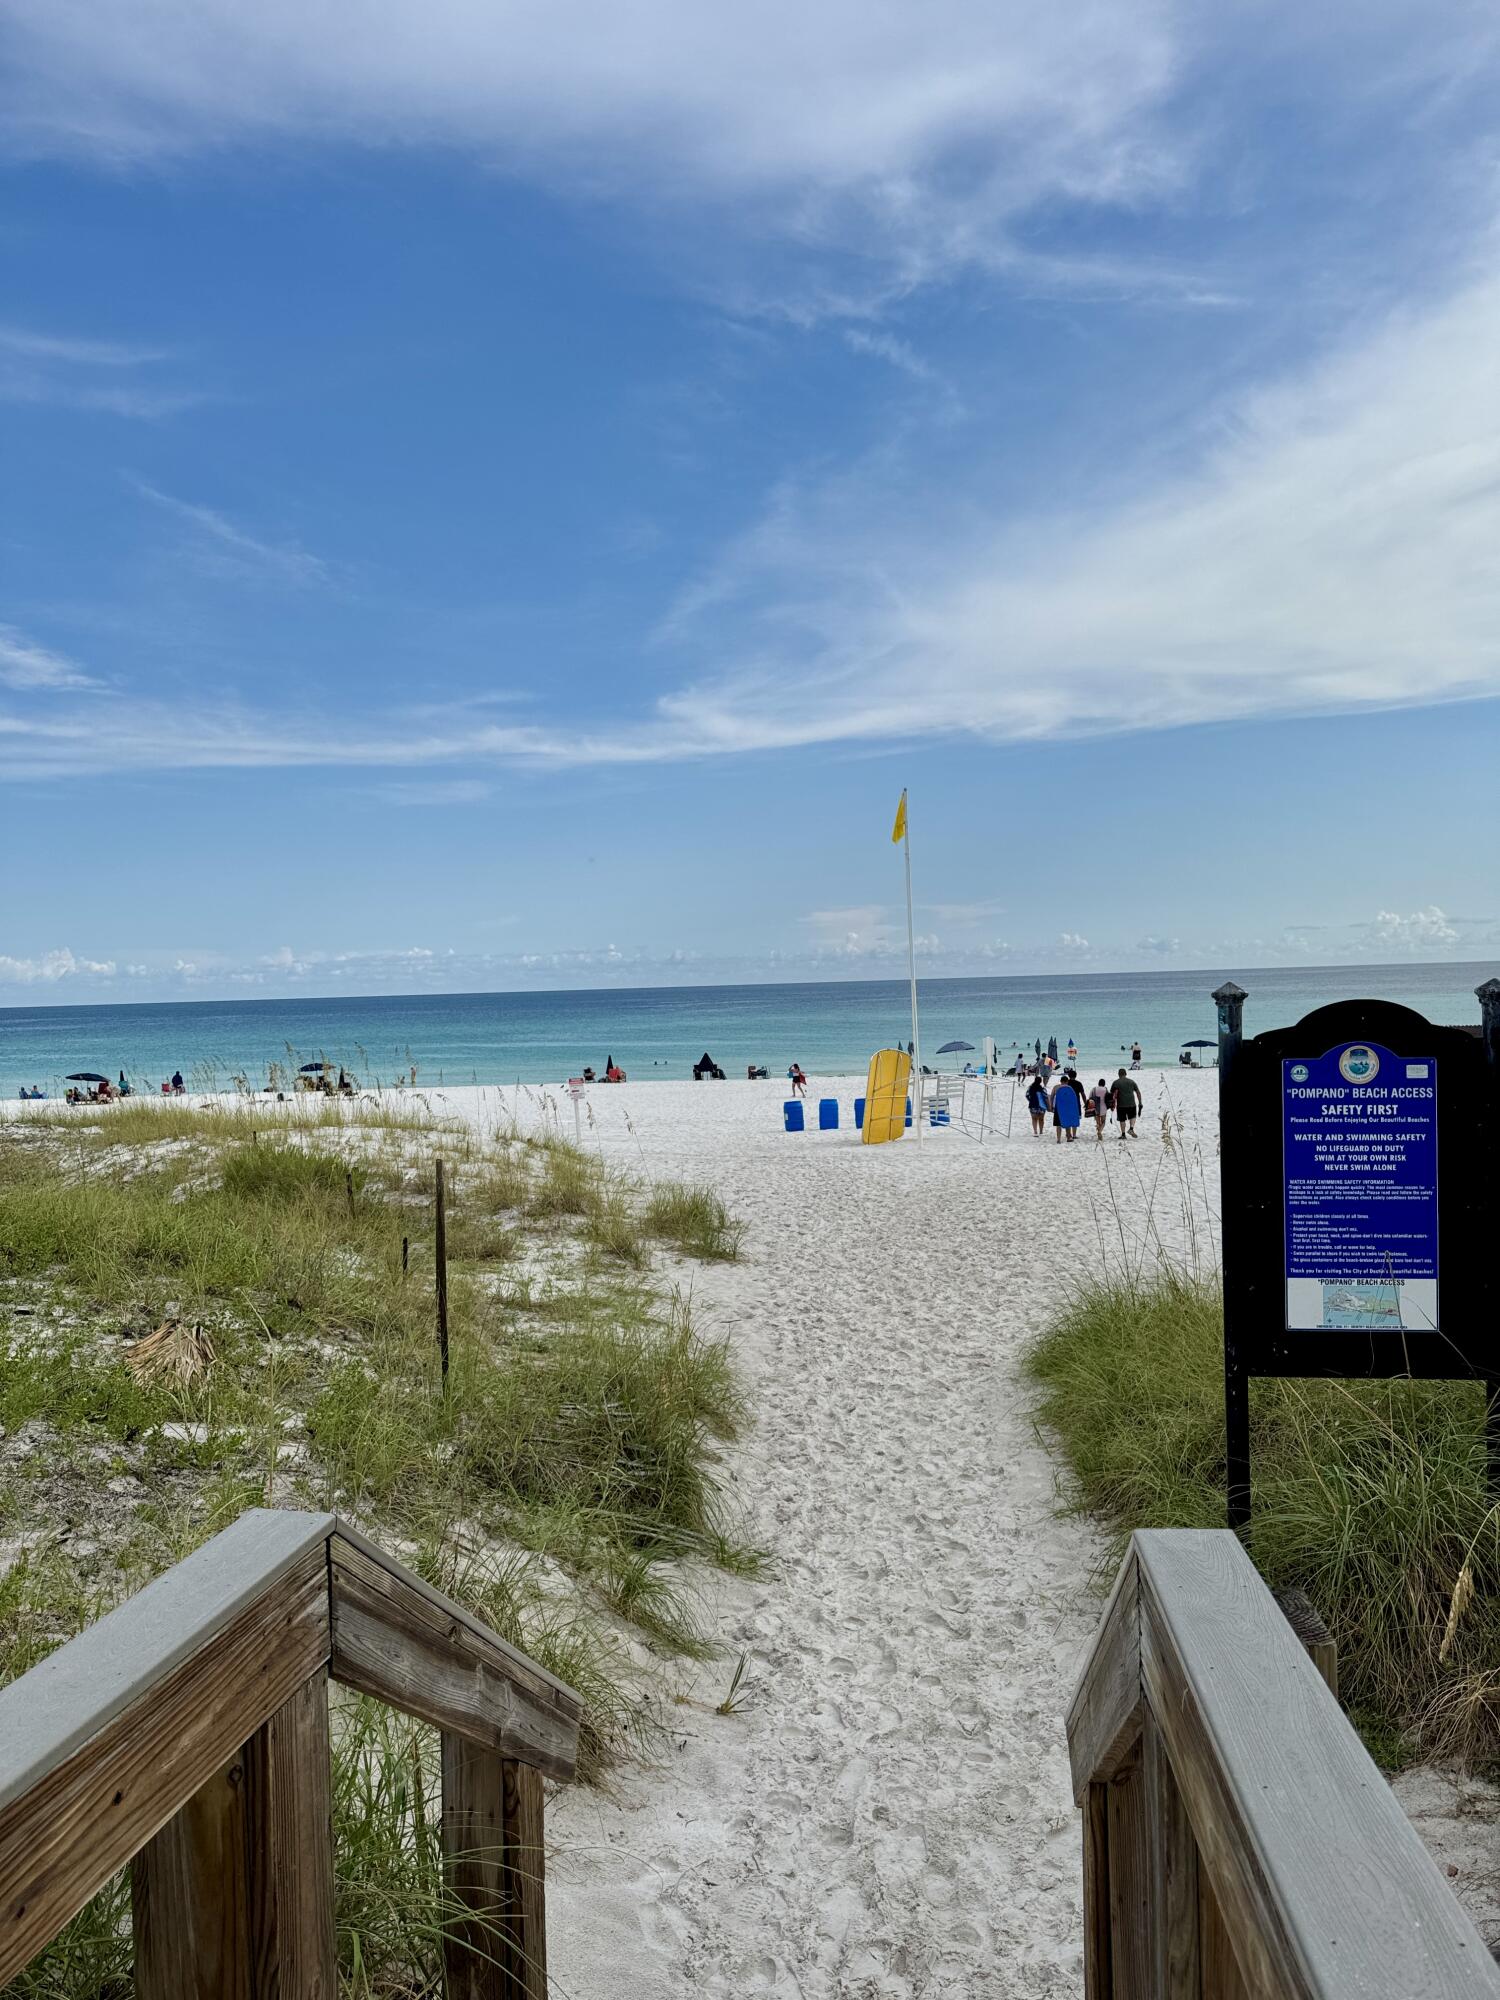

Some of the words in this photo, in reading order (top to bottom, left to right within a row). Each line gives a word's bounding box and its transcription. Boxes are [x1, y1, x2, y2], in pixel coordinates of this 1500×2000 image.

[1287, 1088, 1349, 1098] "POMPANO"
[1352, 1088, 1388, 1098] BEACH
[1391, 1088, 1433, 1098] ACCESS
[1322, 1105, 1362, 1115] SAFETY
[1367, 1105, 1398, 1115] FIRST
